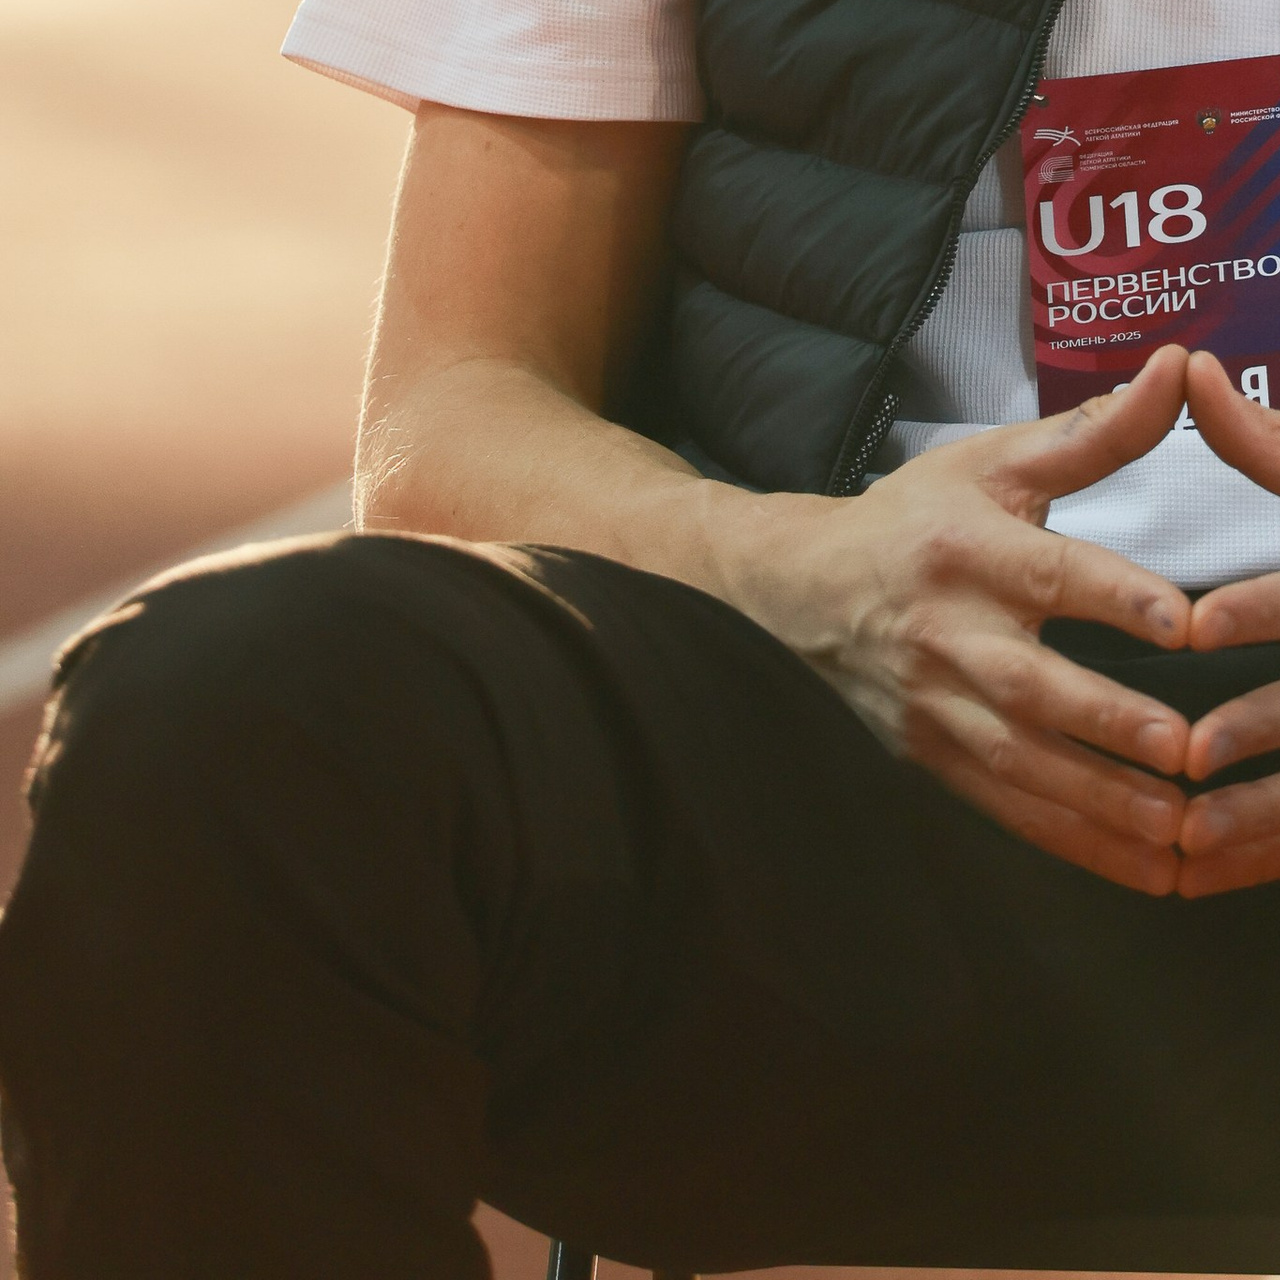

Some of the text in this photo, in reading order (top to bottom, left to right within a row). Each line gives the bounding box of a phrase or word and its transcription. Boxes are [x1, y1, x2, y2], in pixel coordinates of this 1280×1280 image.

[1230, 106, 1280, 118] МИНИСТЕРСТВО
[1230, 113, 1275, 124] РОССИЙСКОЙ
[1084, 119, 1179, 136] ВСЕРОССИЙСКАЯ ФЕДЕРАЦИЯ
[1039, 183, 1207, 257] U18
[1047, 289, 1196, 328] РОССИИ
[1049, 330, 1142, 350] ТЮМЕНЬ 2025
